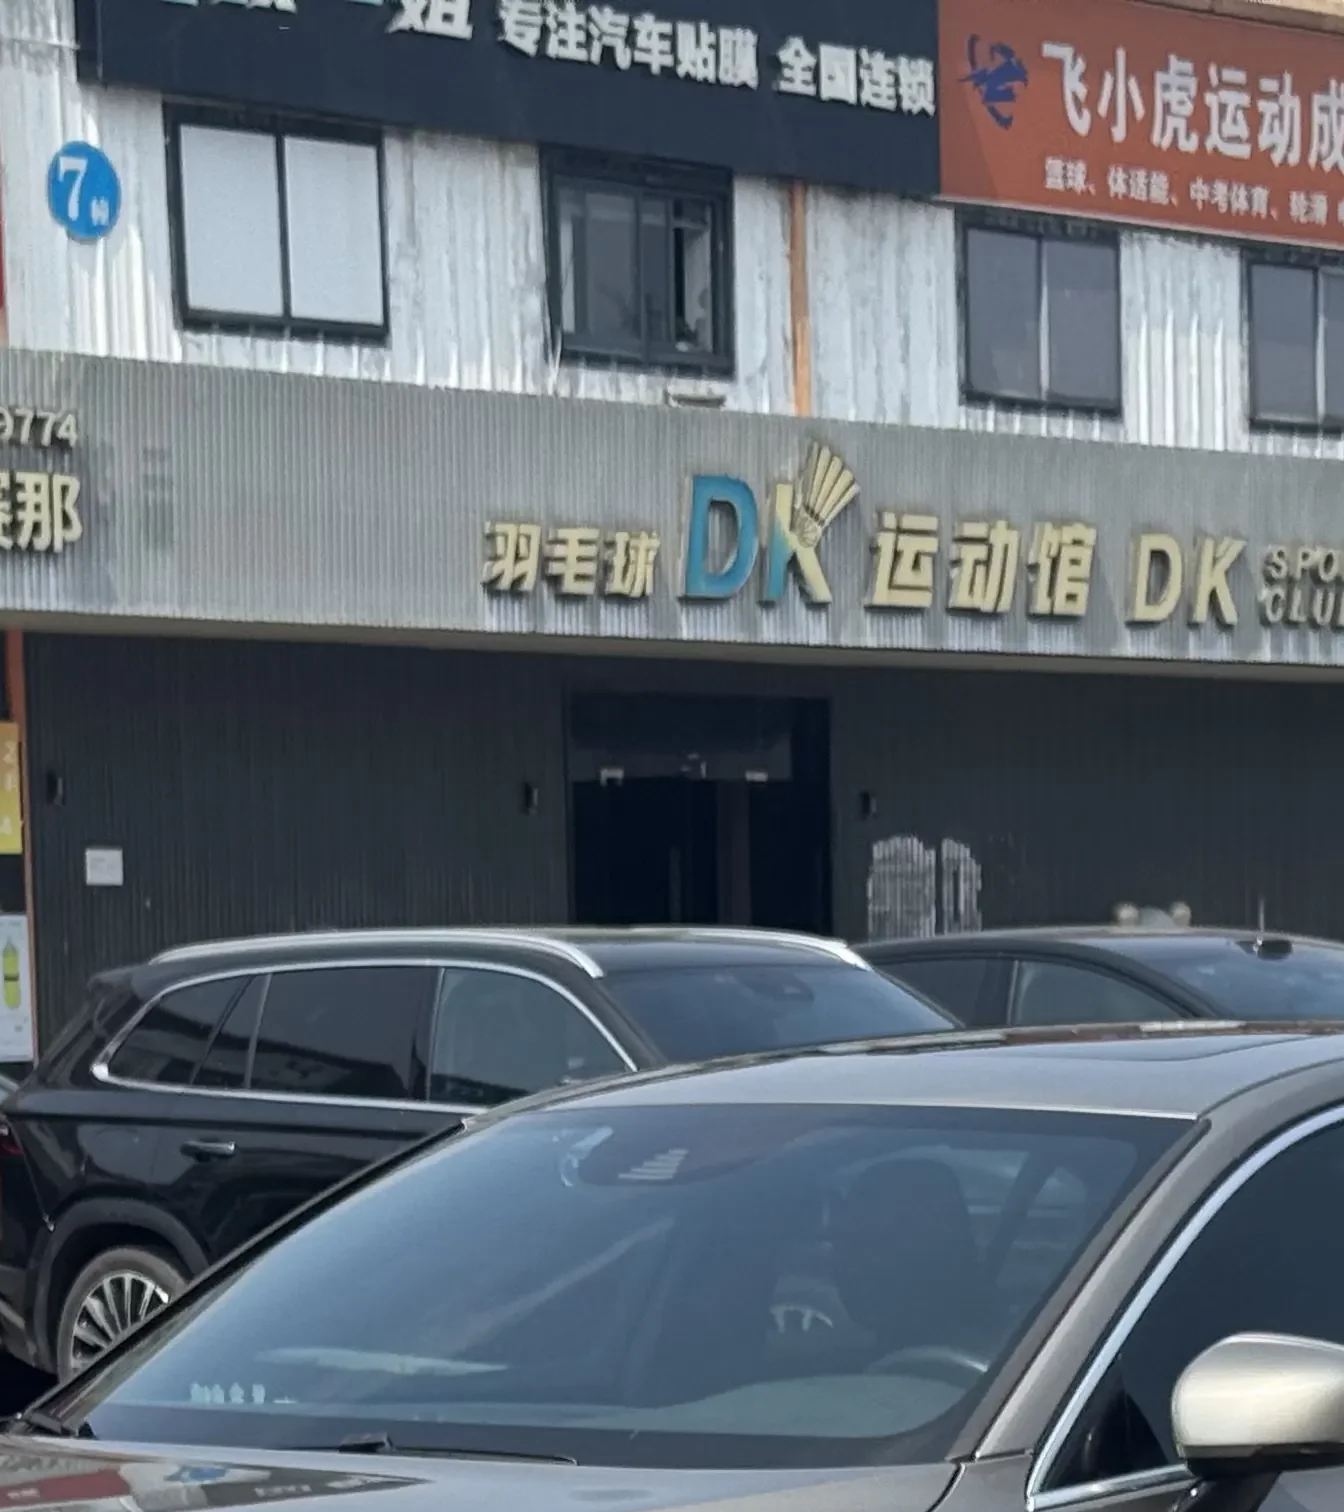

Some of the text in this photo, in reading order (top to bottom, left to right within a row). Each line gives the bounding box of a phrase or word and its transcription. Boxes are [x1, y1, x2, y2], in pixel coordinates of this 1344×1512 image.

[776, 36, 937, 117] 全国连锁
[482, 472, 1246, 625] 羽毛球 DK 运动馆 DK
